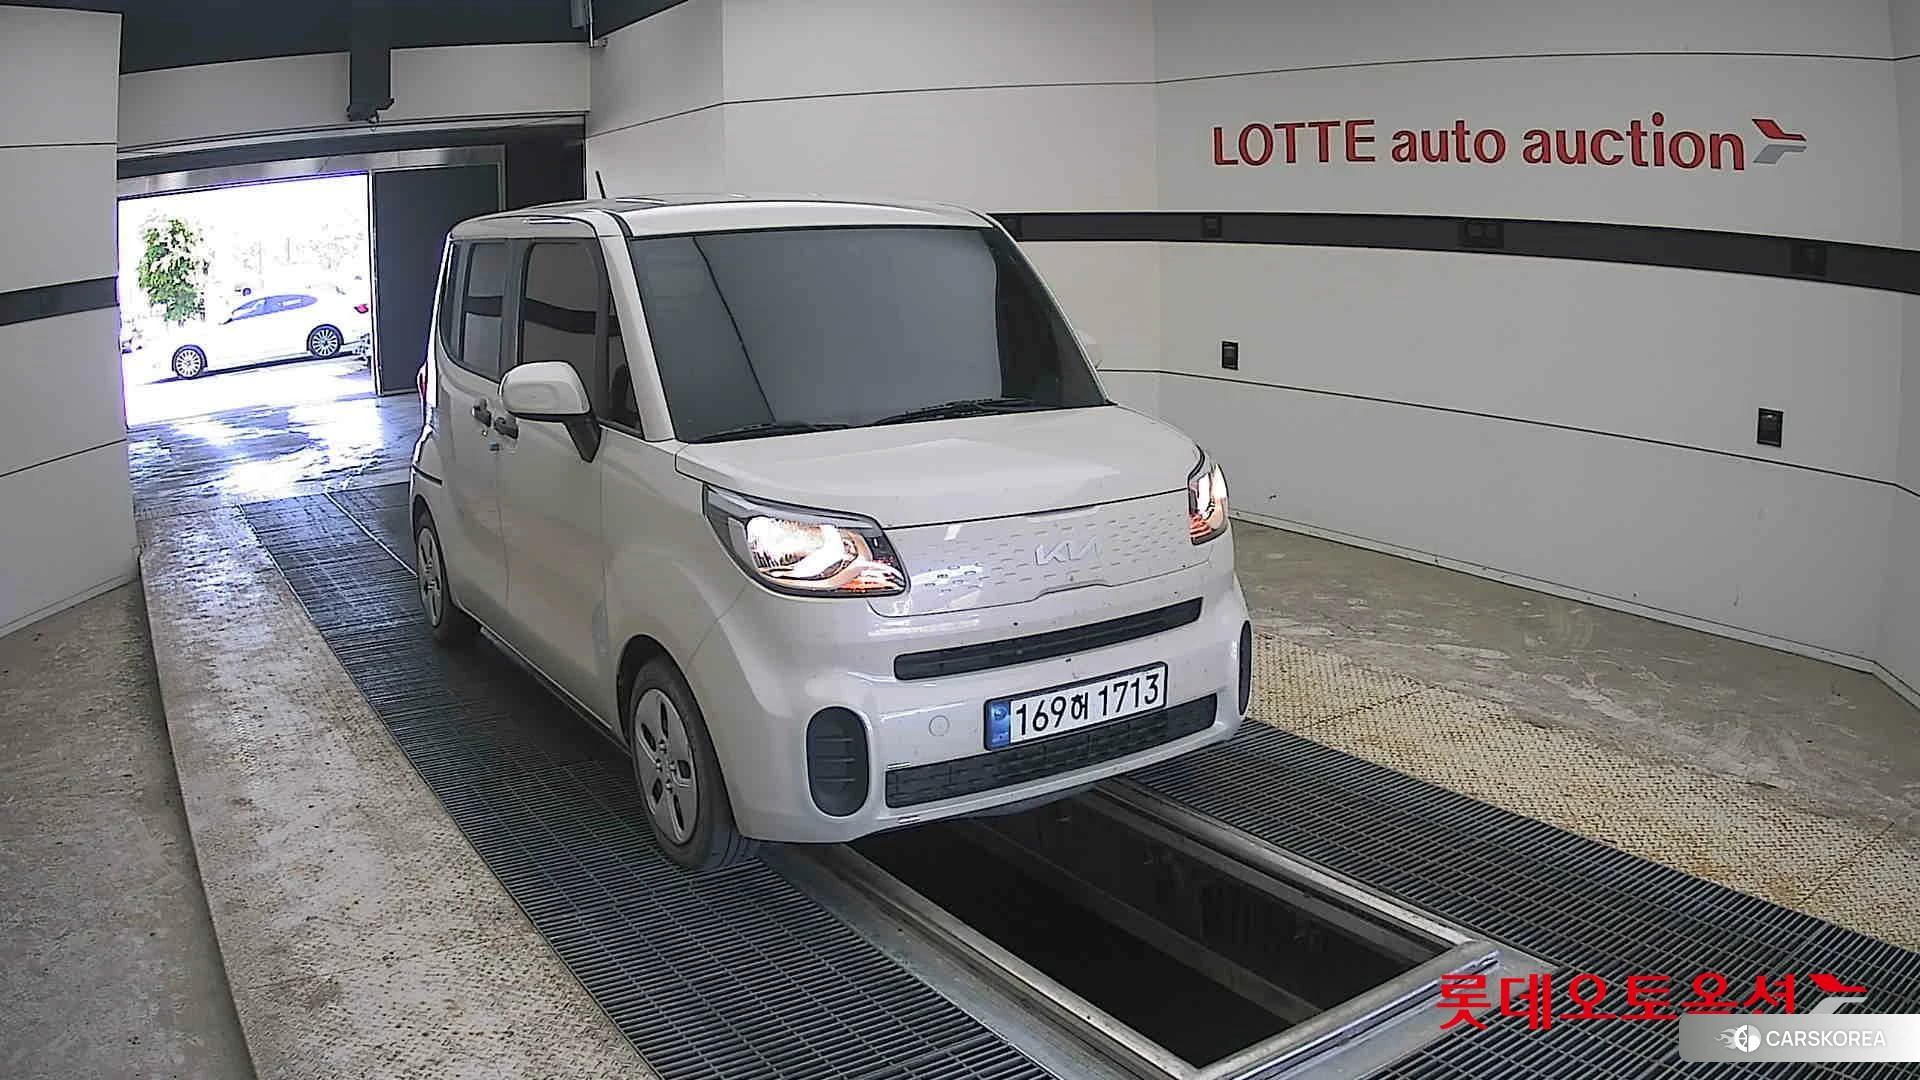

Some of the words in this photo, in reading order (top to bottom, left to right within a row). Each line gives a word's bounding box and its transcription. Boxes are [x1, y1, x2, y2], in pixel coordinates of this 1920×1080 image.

[1213, 118, 1376, 167] LOTTE
[1391, 119, 1507, 165] auto
[1521, 111, 1745, 171] auction
[1016, 691, 1089, 736] 169허
[1098, 673, 1160, 717] 1713
